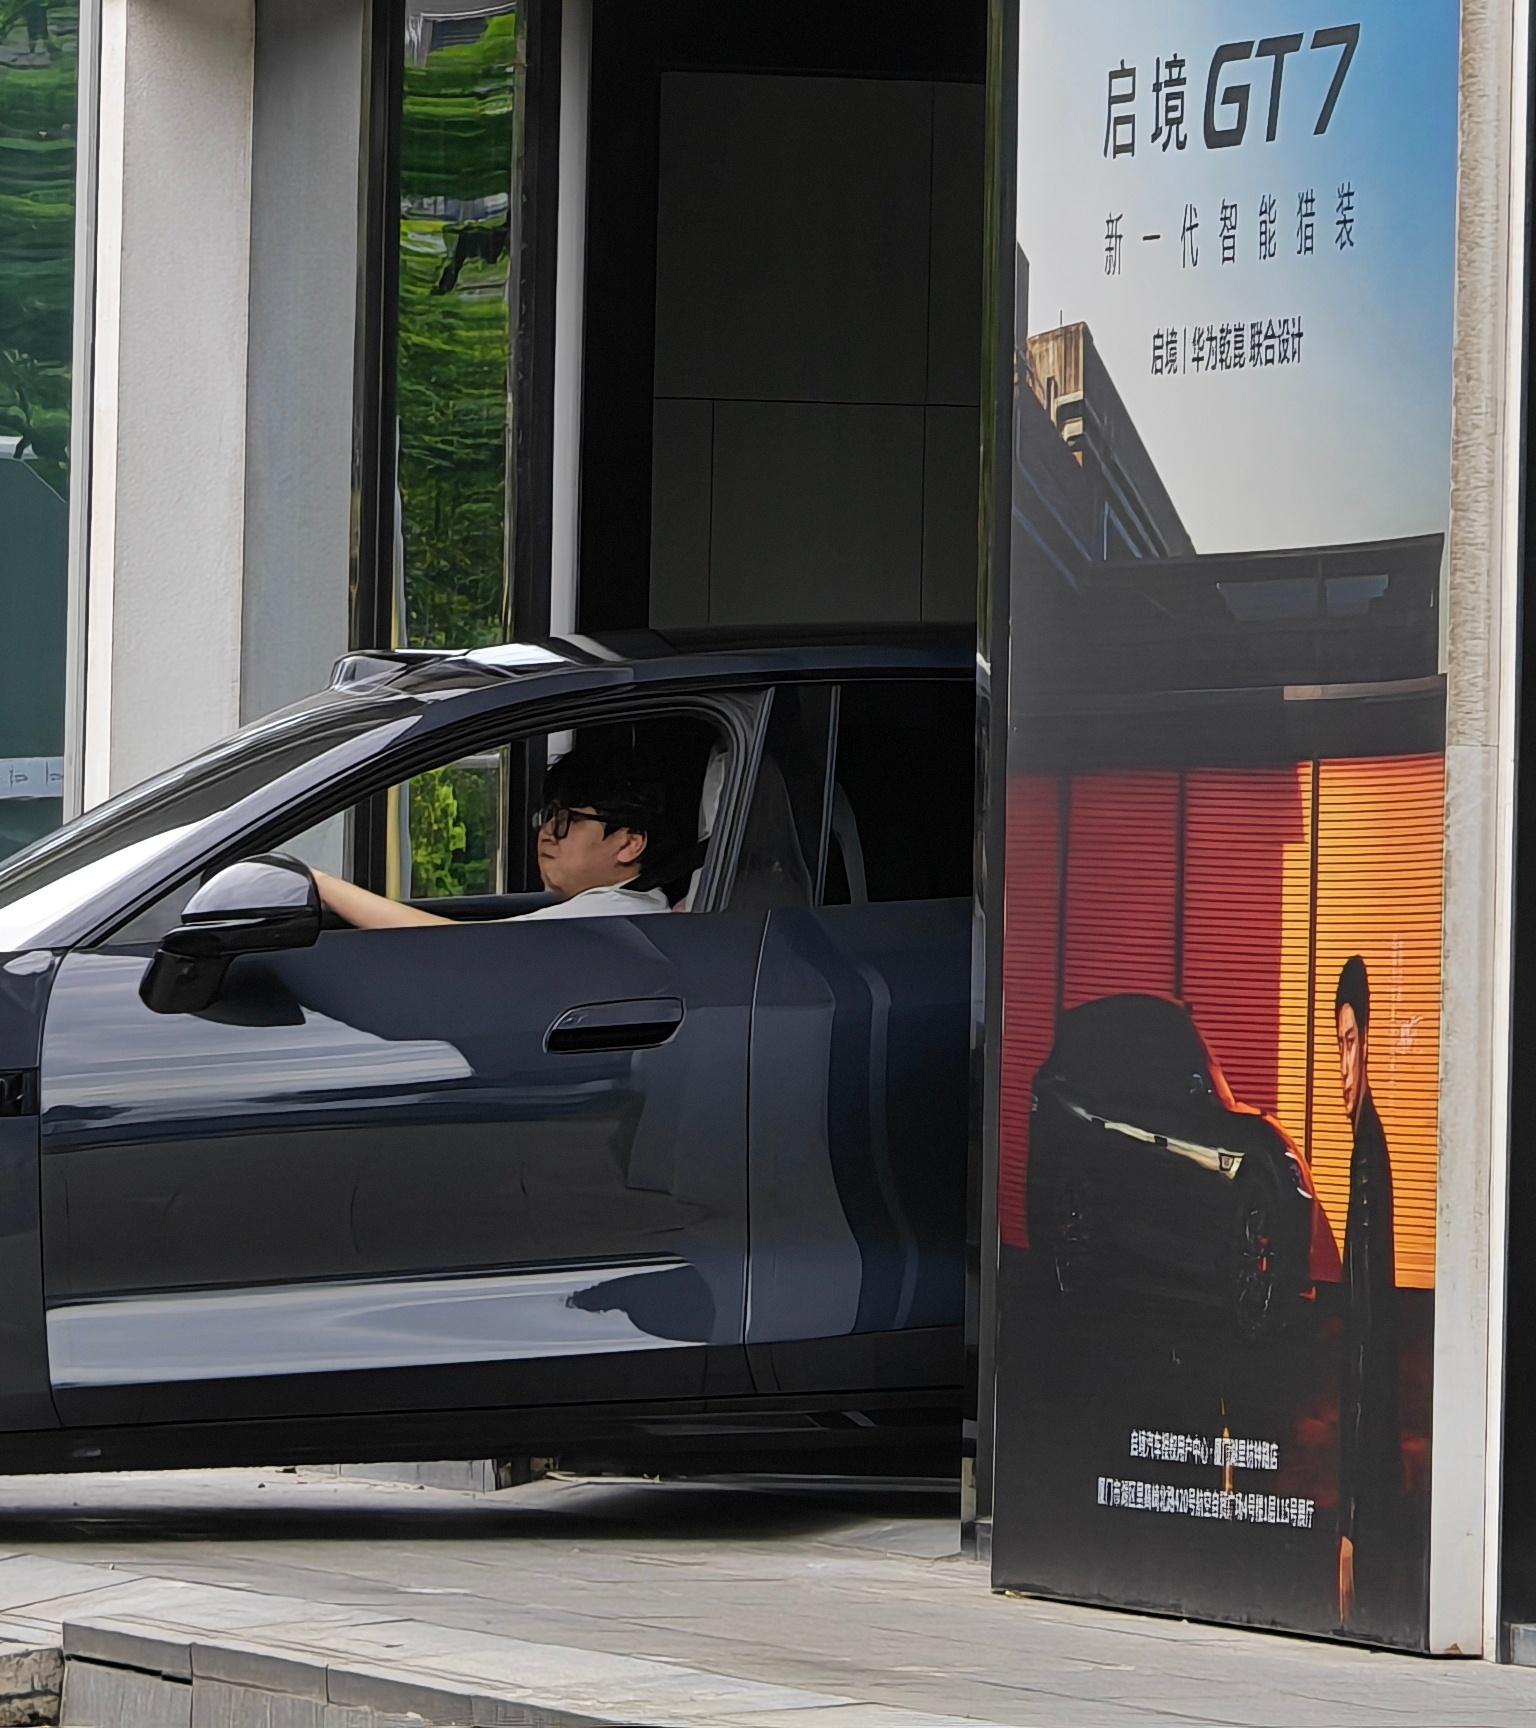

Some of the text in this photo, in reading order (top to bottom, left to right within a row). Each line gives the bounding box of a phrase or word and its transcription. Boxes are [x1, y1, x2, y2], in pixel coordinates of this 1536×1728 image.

[1104, 181, 1356, 276] 新一代智能猎装
